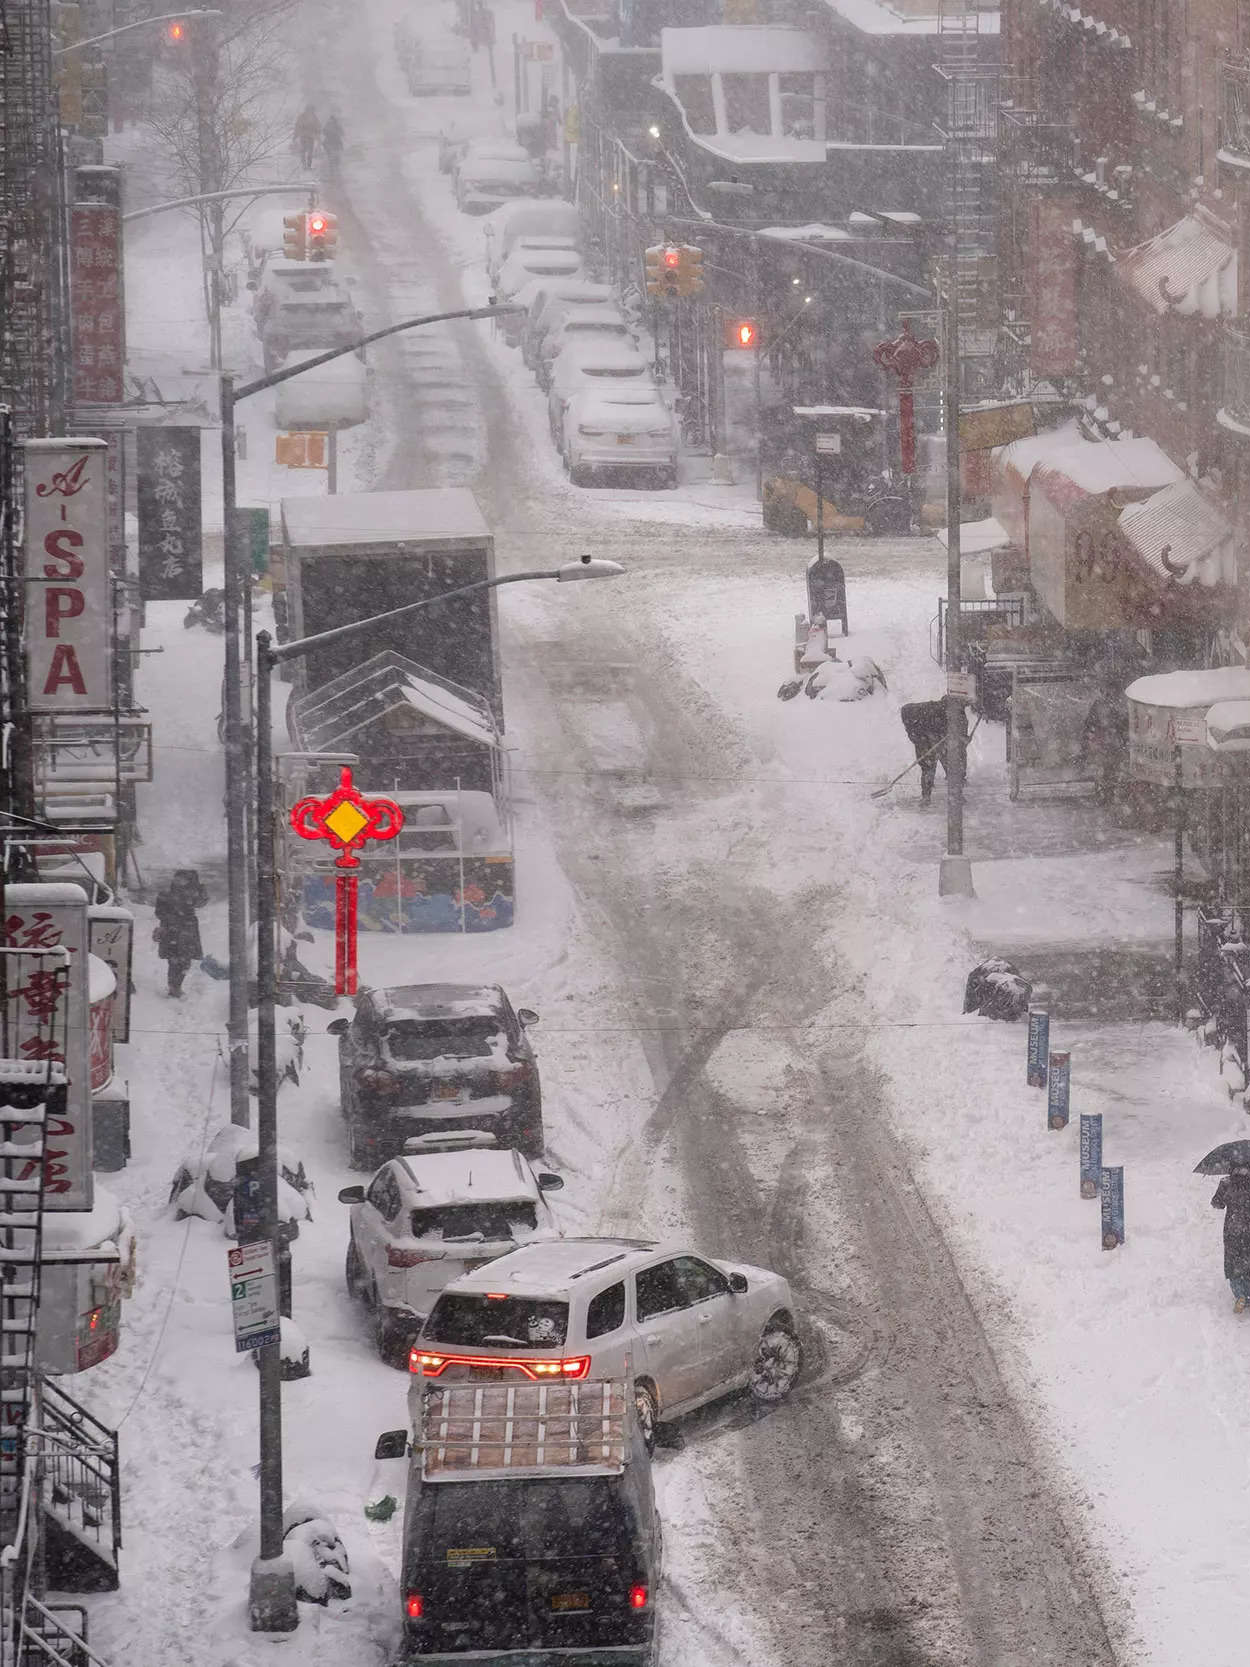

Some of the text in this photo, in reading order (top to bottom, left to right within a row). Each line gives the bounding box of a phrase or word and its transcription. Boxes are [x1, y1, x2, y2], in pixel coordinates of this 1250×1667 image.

[1030, 1016, 1040, 1065] MUSEUM
[1050, 1067, 1060, 1106] MUSEU
[1081, 1119, 1091, 1170] MUSEUM
[1102, 1170, 1111, 1222] MUSEUM
